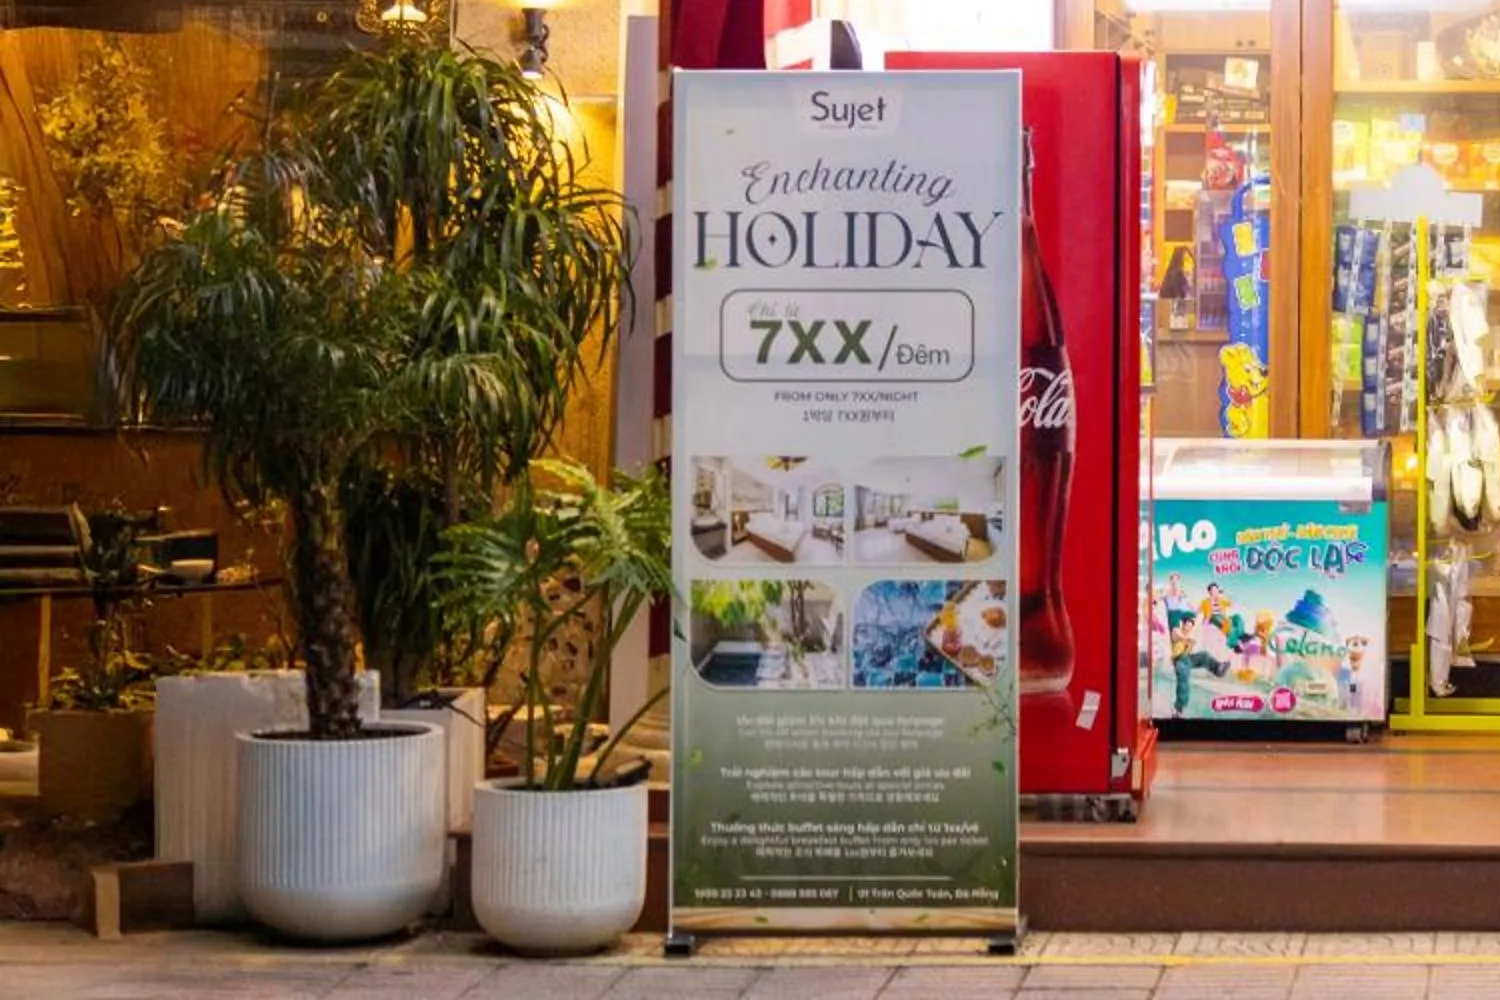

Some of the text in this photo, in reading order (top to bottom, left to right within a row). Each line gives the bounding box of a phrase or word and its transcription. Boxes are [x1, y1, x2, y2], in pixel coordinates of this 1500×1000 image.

[810, 91, 888, 130] Sujet
[740, 157, 955, 207] Enchanting
[693, 210, 1004, 269] HOLIDAY
[773, 391, 812, 402] FROM
[815, 391, 849, 402] ONLY
